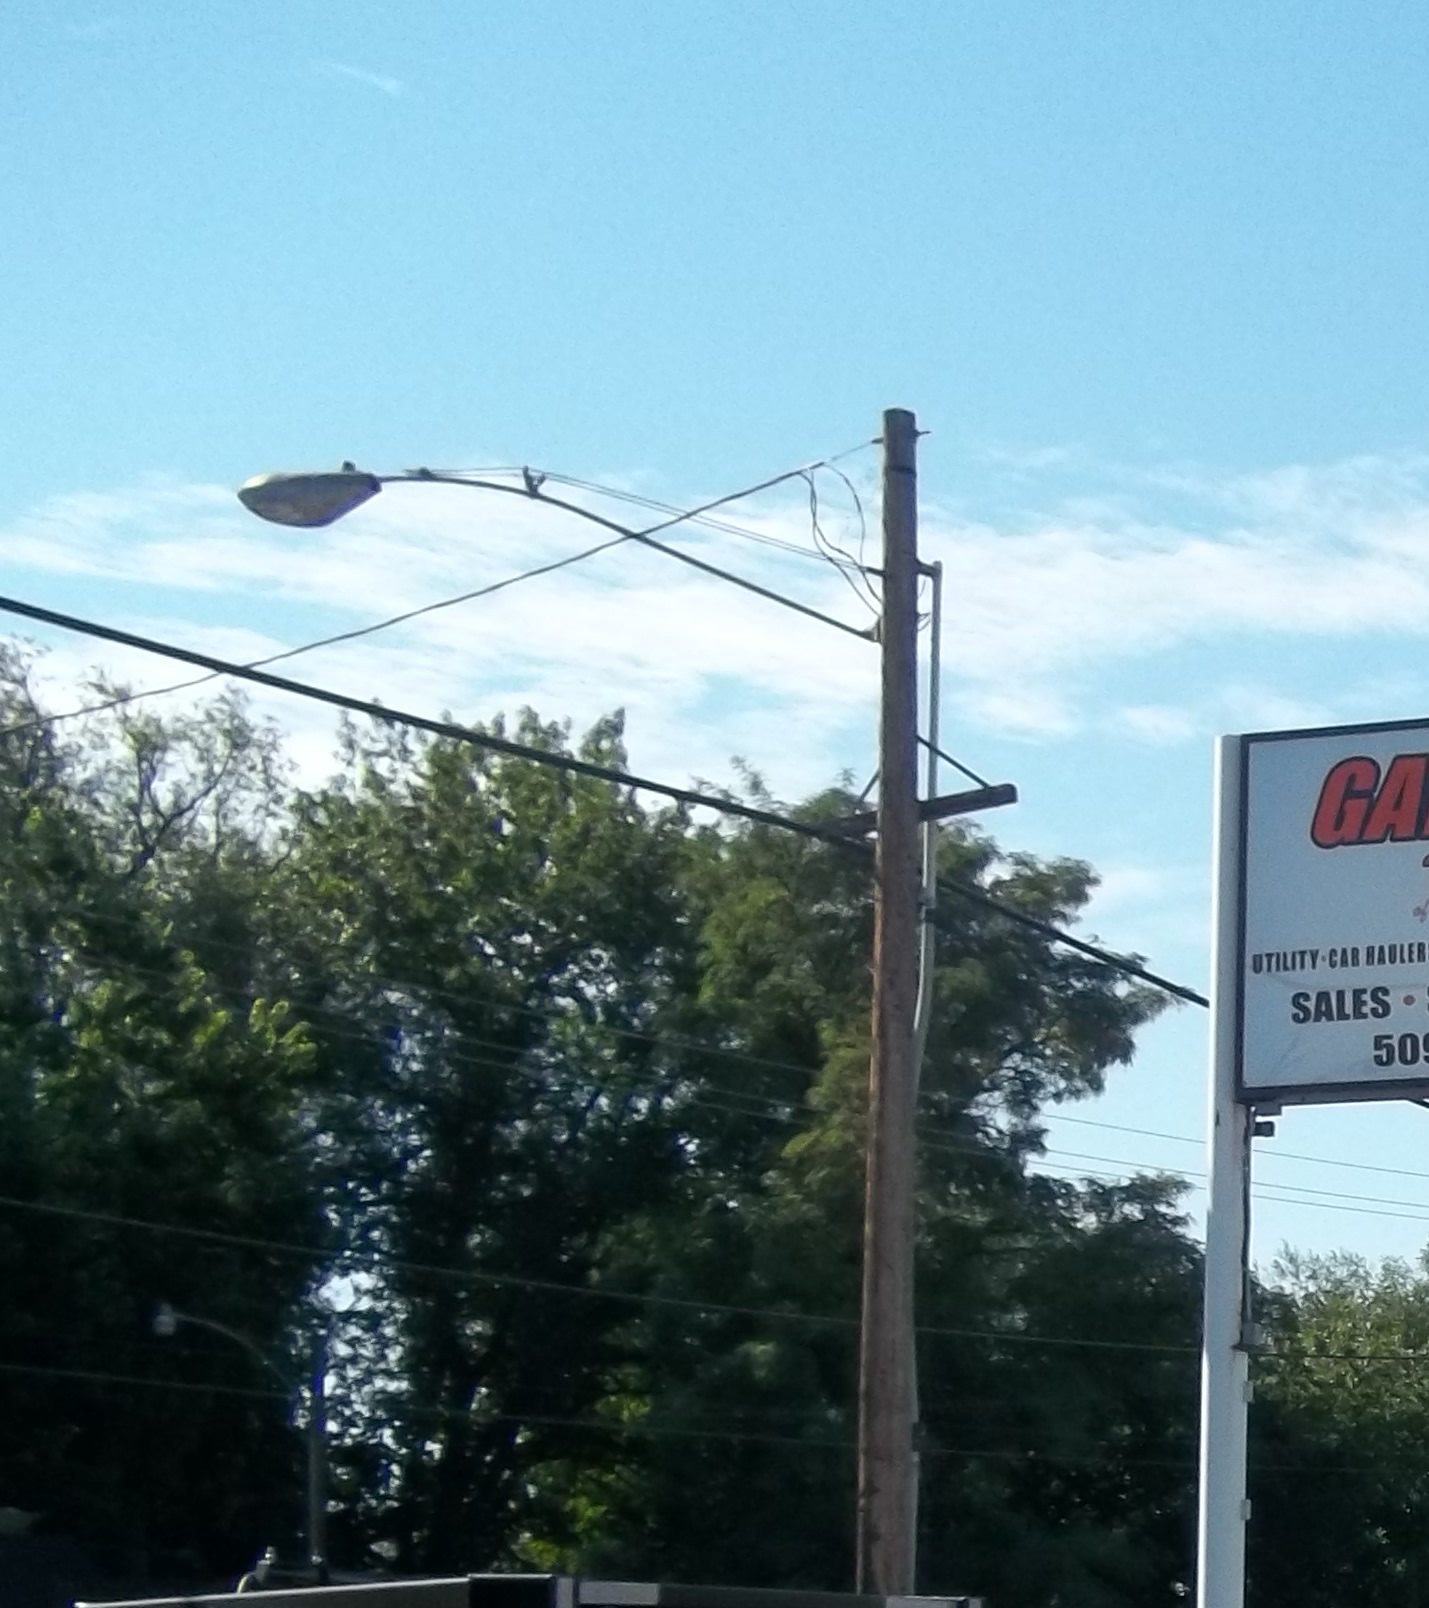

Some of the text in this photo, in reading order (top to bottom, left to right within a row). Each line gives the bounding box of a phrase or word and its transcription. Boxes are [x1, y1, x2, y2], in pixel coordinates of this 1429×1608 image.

[1413, 899, 1429, 924] of
[1252, 949, 1319, 974] UTILITY
[1328, 947, 1360, 969] CAR
[1291, 986, 1391, 1024] SALES
